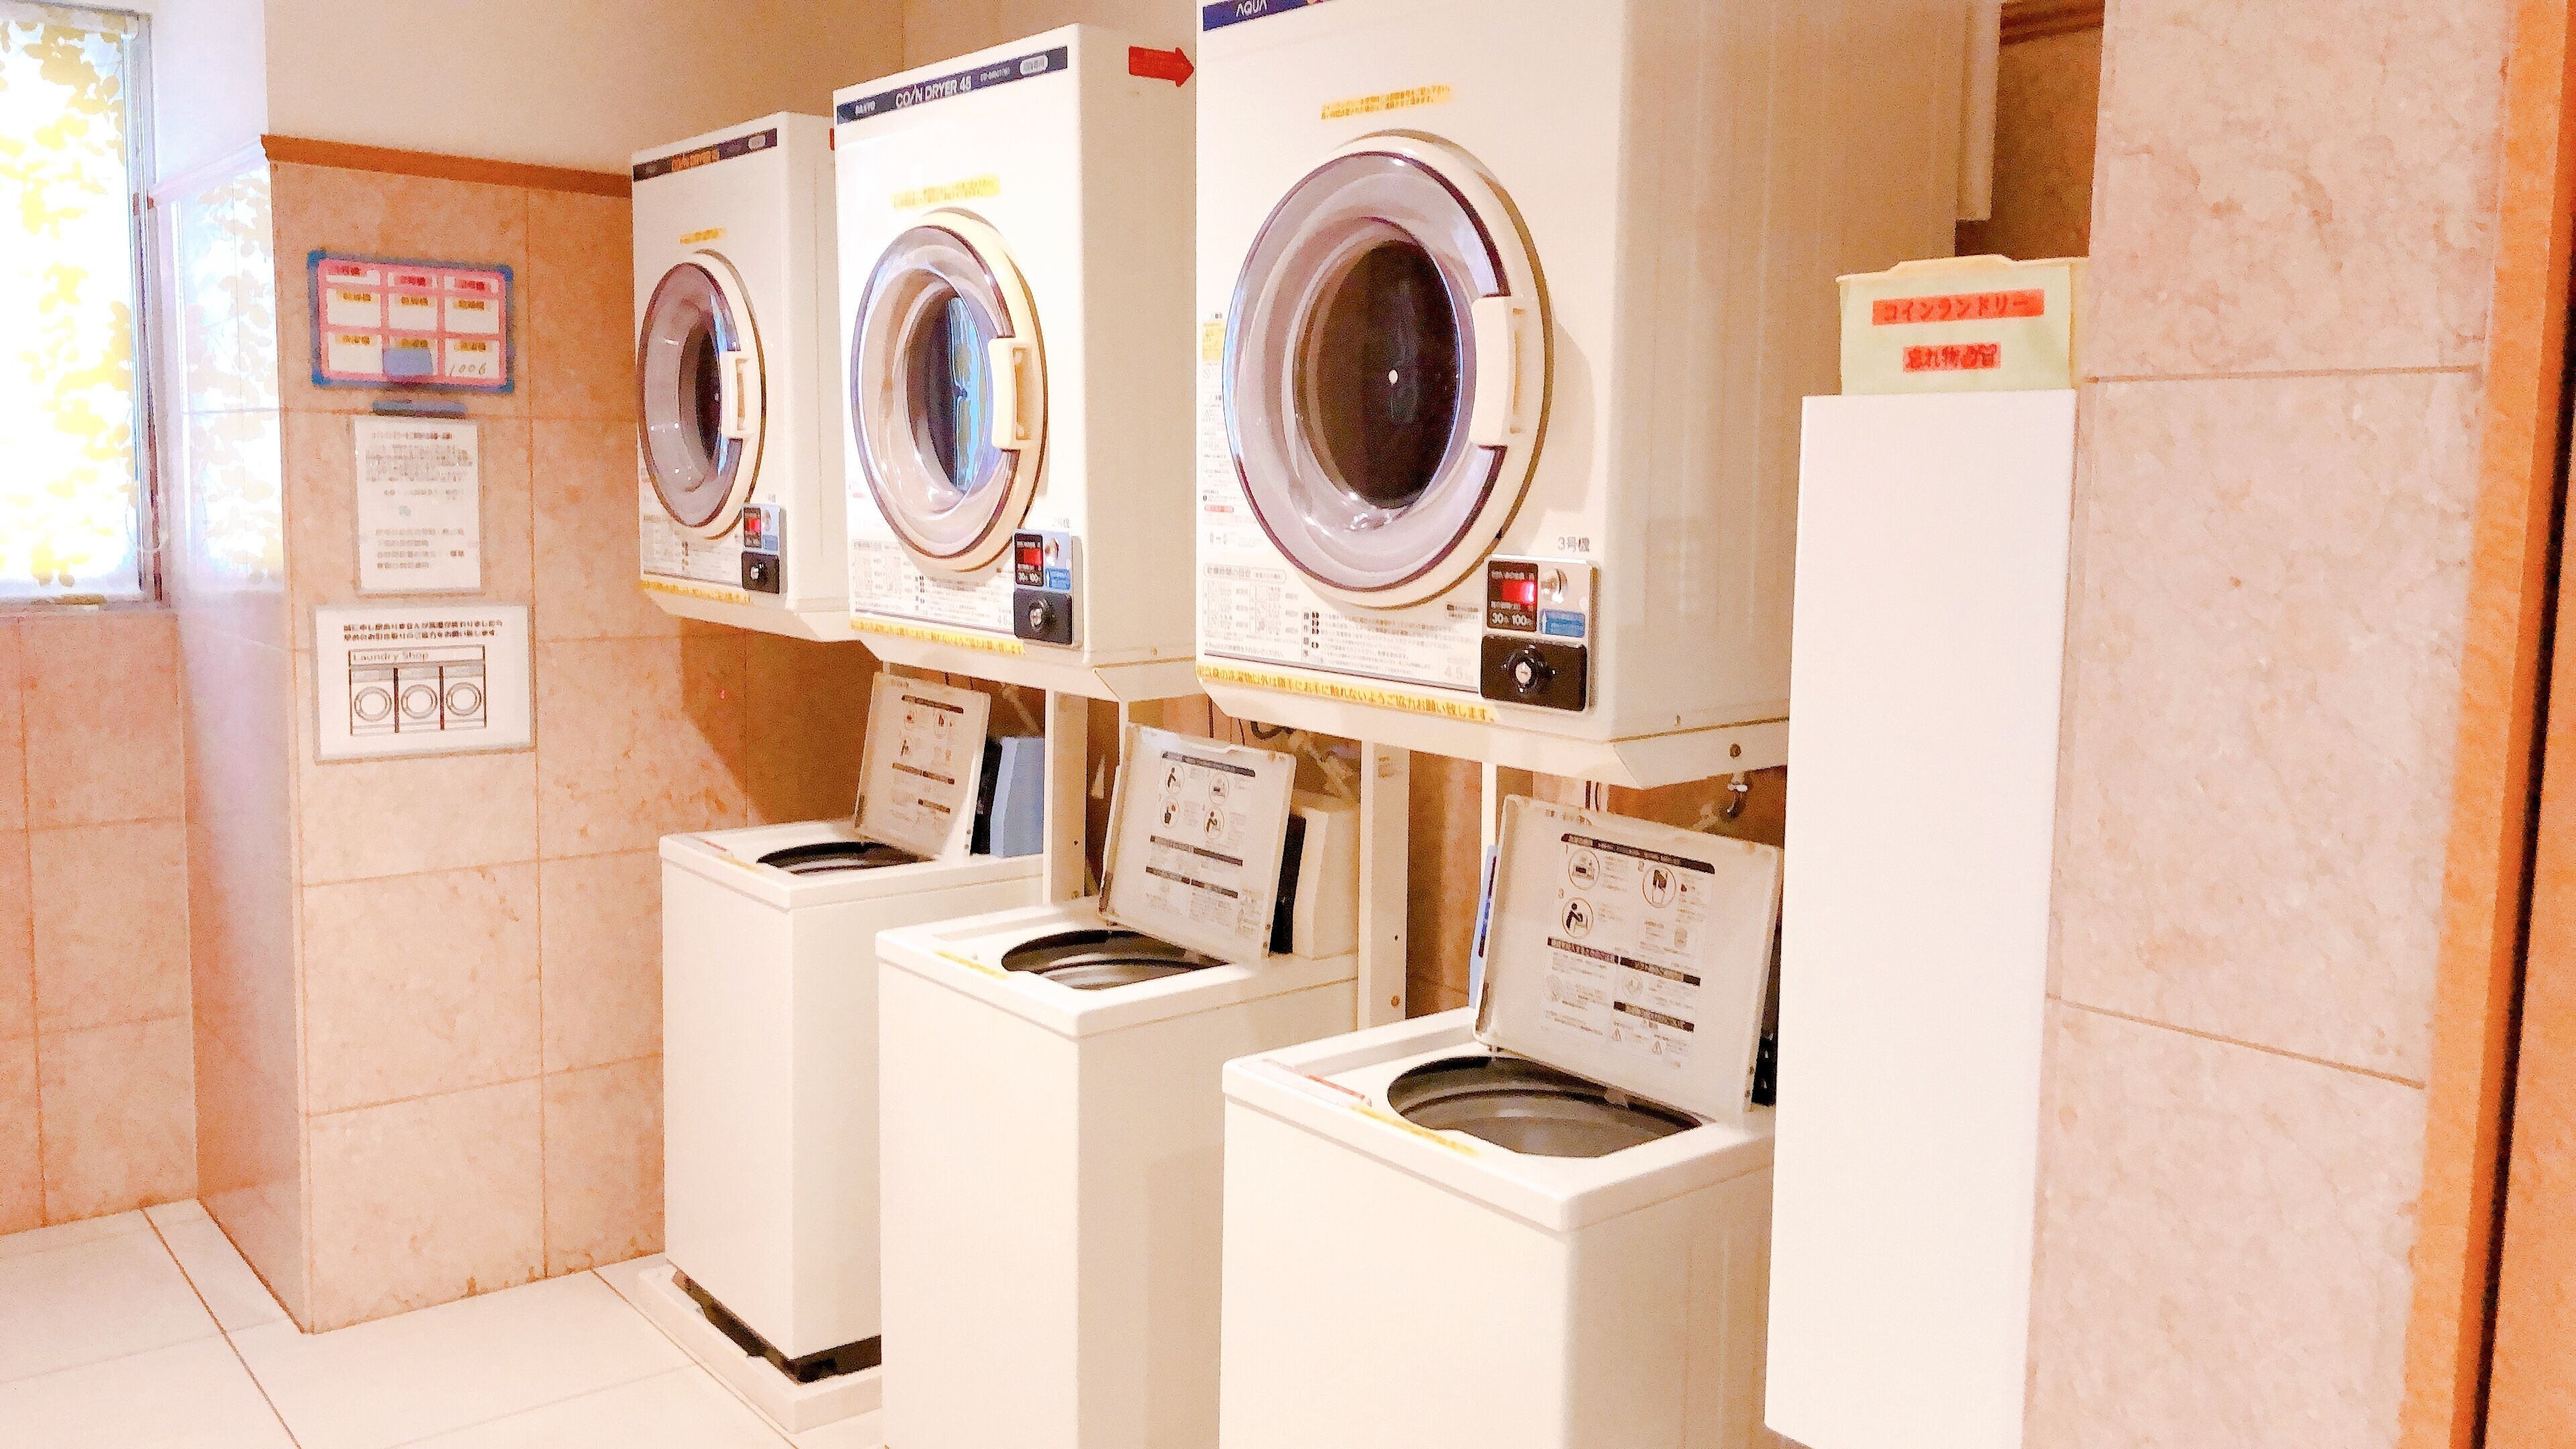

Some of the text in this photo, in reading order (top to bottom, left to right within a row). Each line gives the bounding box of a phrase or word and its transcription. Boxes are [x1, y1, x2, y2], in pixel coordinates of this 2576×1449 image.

[1236, 0, 1267, 17] AQUA
[925, 79, 957, 100] DRYER
[1884, 294, 2029, 321] コインランドリー
[1558, 536, 1590, 553] 3号機
[354, 651, 429, 661] Laundry Shop
